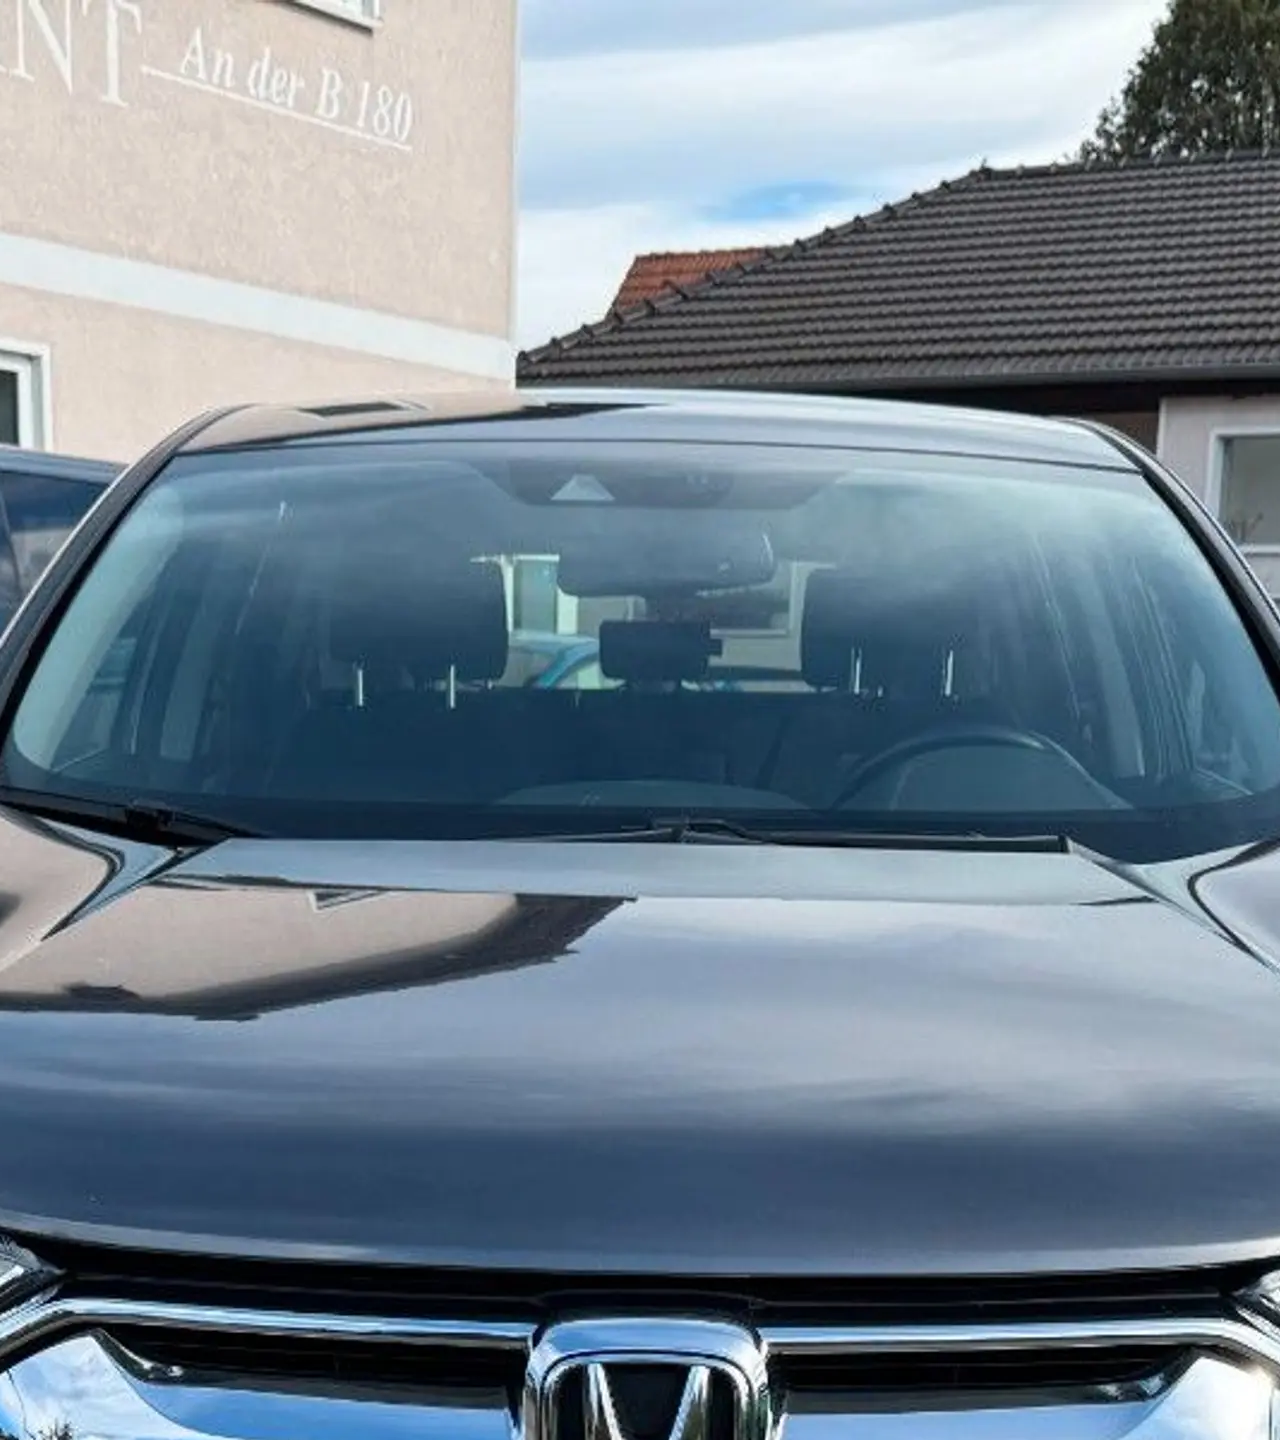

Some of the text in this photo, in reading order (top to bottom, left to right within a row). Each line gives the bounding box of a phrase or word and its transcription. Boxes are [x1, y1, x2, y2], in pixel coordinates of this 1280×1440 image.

[179, 26, 235, 88] An
[247, 47, 305, 109] der
[315, 66, 342, 119] B
[356, 81, 412, 142] 180
